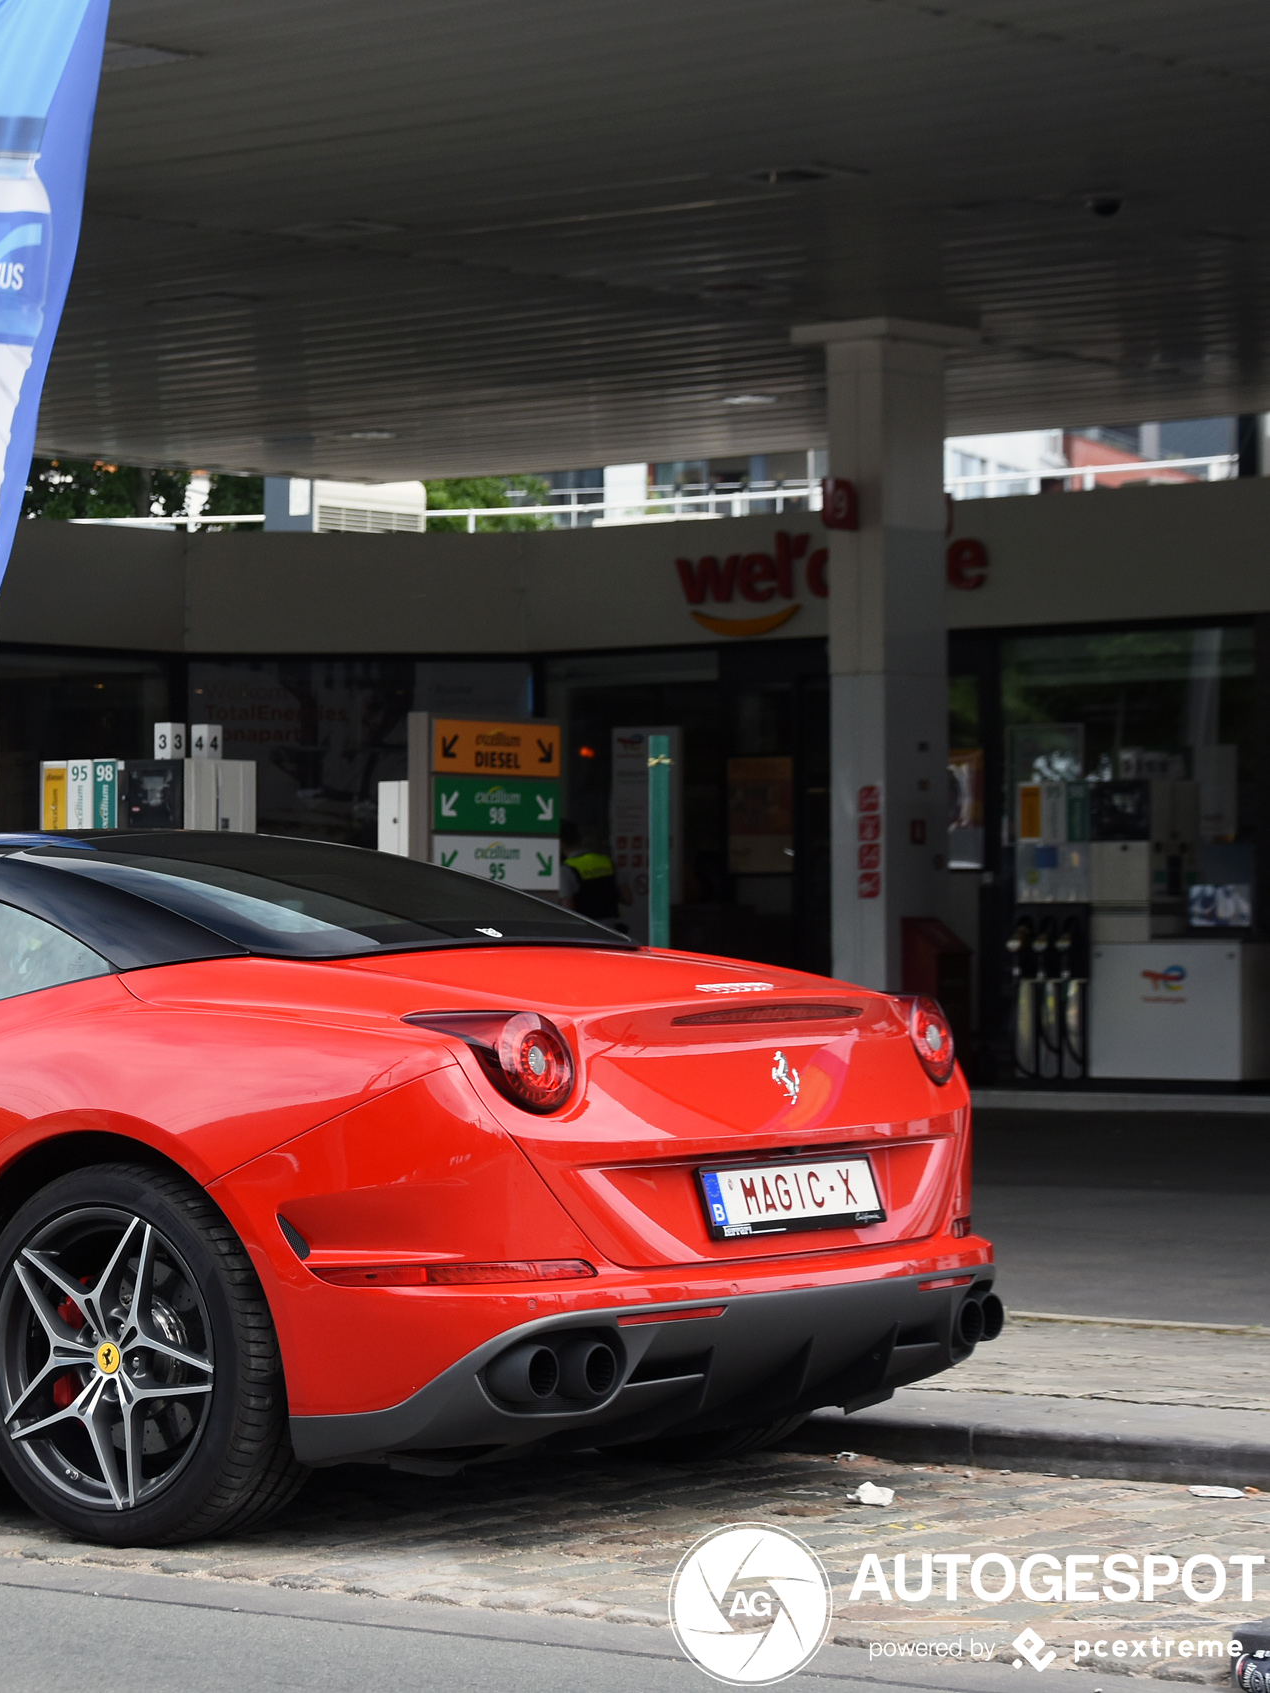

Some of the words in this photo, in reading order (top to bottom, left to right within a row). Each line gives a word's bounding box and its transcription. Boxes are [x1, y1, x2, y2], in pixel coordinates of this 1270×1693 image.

[158, 734, 168, 749] 3
[174, 734, 183, 749] 3
[195, 736, 203, 750] 4
[210, 736, 218, 750] 4
[475, 751, 520, 769] DIESEL
[72, 766, 88, 781] 95
[96, 764, 114, 782] 98
[489, 807, 506, 825] 98
[489, 863, 505, 880] 95
[740, 1169, 858, 1215] MAGIC-X
[712, 1204, 726, 1222] B
[723, 1223, 753, 1237] Ferrari
